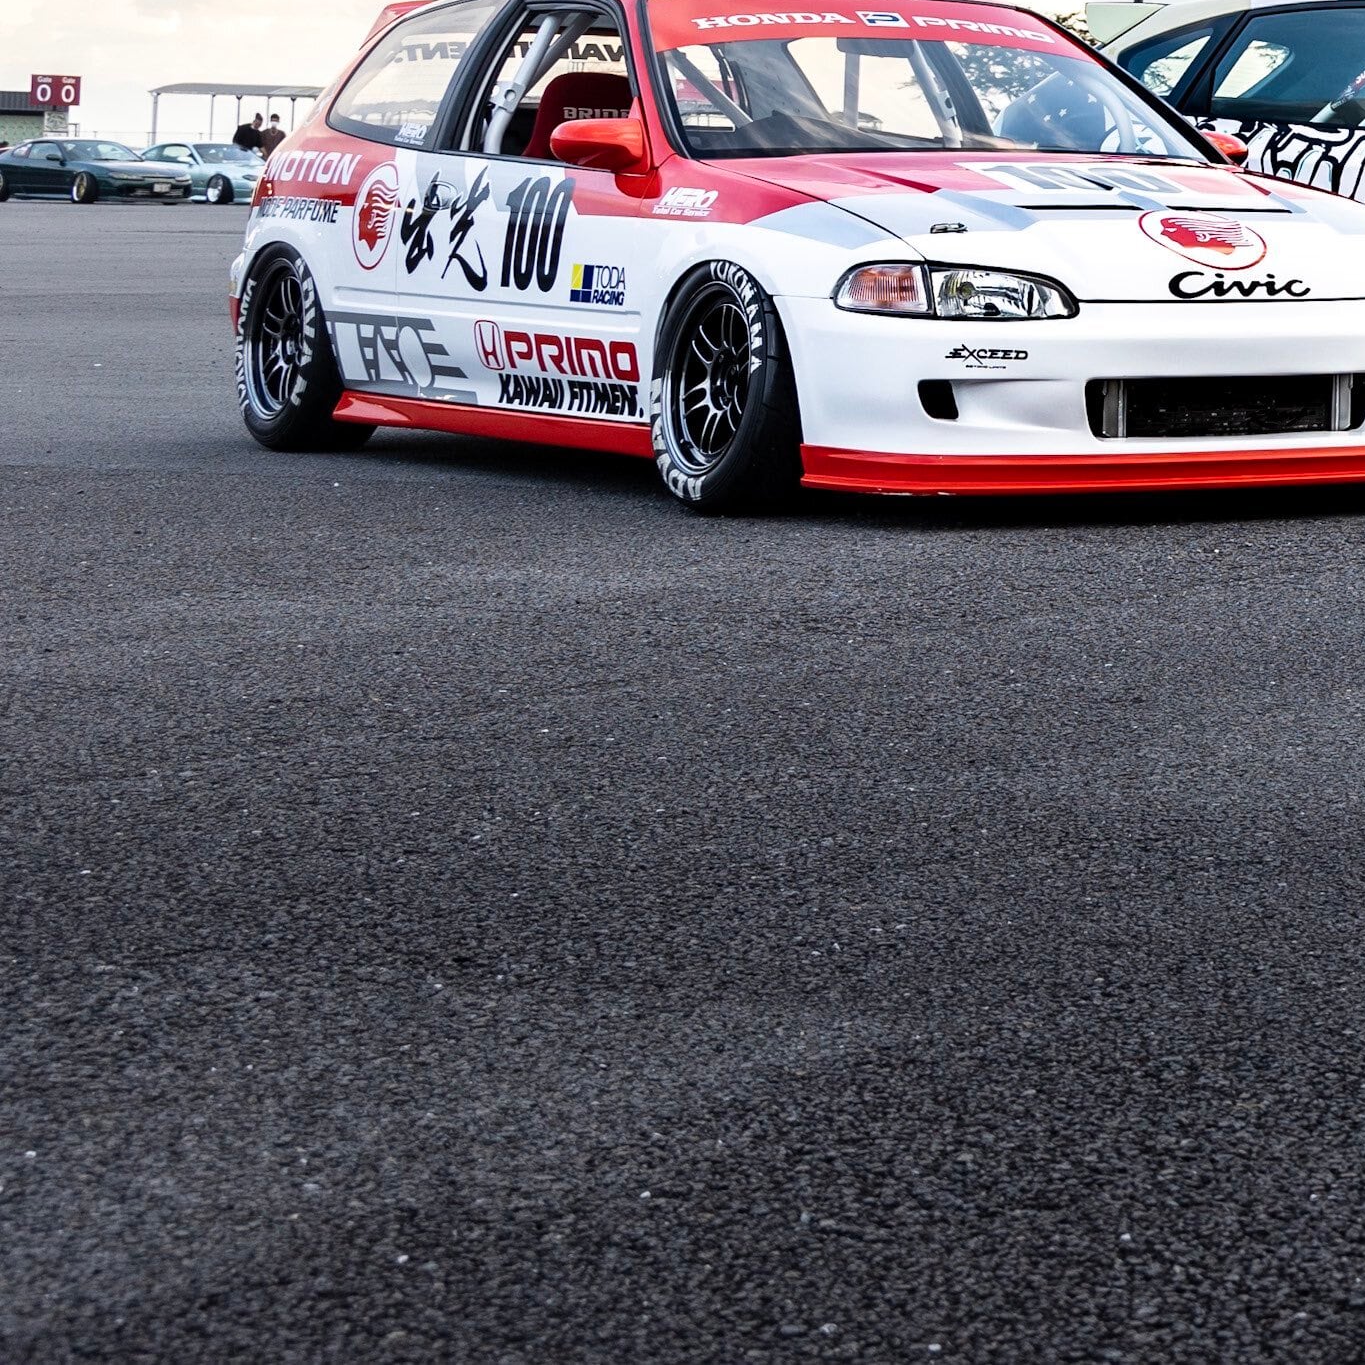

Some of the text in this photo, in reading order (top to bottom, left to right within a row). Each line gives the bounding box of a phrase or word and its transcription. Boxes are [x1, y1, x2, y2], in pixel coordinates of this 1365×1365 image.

[691, 12, 856, 30] HONDA
[912, 16, 1055, 43] PRIMO
[264, 151, 362, 185] MOTION
[984, 164, 1184, 194] 100
[281, 198, 341, 224] PARFUME
[500, 177, 577, 292] 100
[595, 265, 626, 290] TODA
[1168, 271, 1311, 299] Civic
[591, 290, 625, 306] RACING
[710, 260, 763, 374] YOKOHAMA
[503, 330, 640, 383] PRIMO
[945, 343, 1028, 365] EXCEED
[499, 373, 564, 409] KAWAII
[650, 378, 706, 501] ADVAN
